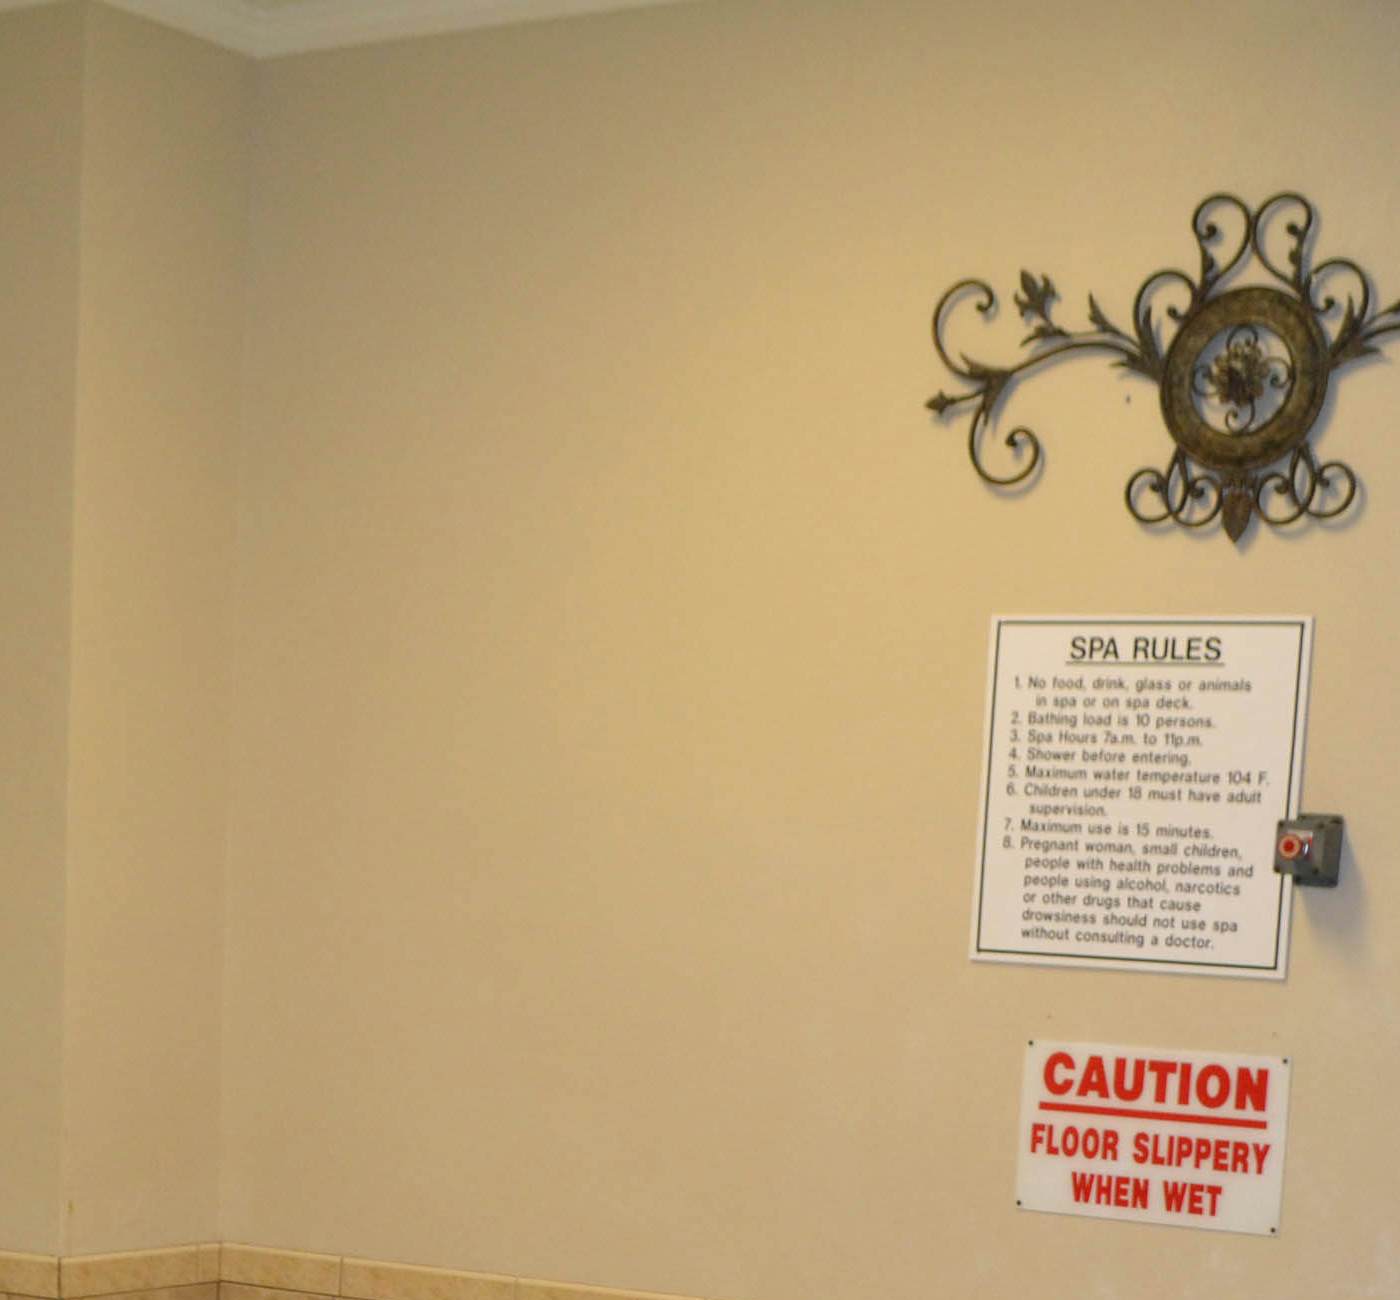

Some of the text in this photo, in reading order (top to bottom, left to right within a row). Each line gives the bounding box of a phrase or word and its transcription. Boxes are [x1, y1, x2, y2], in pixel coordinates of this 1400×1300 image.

[1070, 636, 1222, 661] SPA RULES
[1014, 676, 1252, 693] 1. No food, drink, glass or animals
[1035, 695, 1193, 711] in spa or on spa deck.
[1011, 710, 1216, 730] 2. Bathing load is 10 persons.
[1009, 728, 1020, 743] 3.
[1027, 729, 1053, 745] Spa
[1058, 730, 1097, 744] Hours
[1143, 733, 1158, 745] to
[1008, 747, 1192, 767] 4. Shower before entering.
[1007, 764, 1270, 787] 5. Maximum water temperature 104 F.
[1006, 782, 1262, 805] 6. Children under 18 must have adult
[1028, 803, 1107, 817] supervision.
[1004, 817, 1215, 840] 7. Maximum use is 15 minutes.
[1002, 835, 1015, 850] 8.
[1020, 836, 1079, 854] Pregnant
[1141, 843, 1178, 856] small
[1183, 844, 1243, 861] children,
[1024, 856, 1255, 879] people with health problems and
[1023, 874, 1242, 897] people using alcohol, narcotics
[1022, 891, 1203, 913] or other drugs that cause
[1021, 909, 1239, 936] drowsiness should not use spa
[1020, 927, 1215, 952] without consulting a doctor.
[1044, 1052, 1269, 1112] CAUTION
[1031, 1123, 1271, 1176] FLOOR SLIPPERY
[1071, 1171, 1223, 1218] WHEN WET
